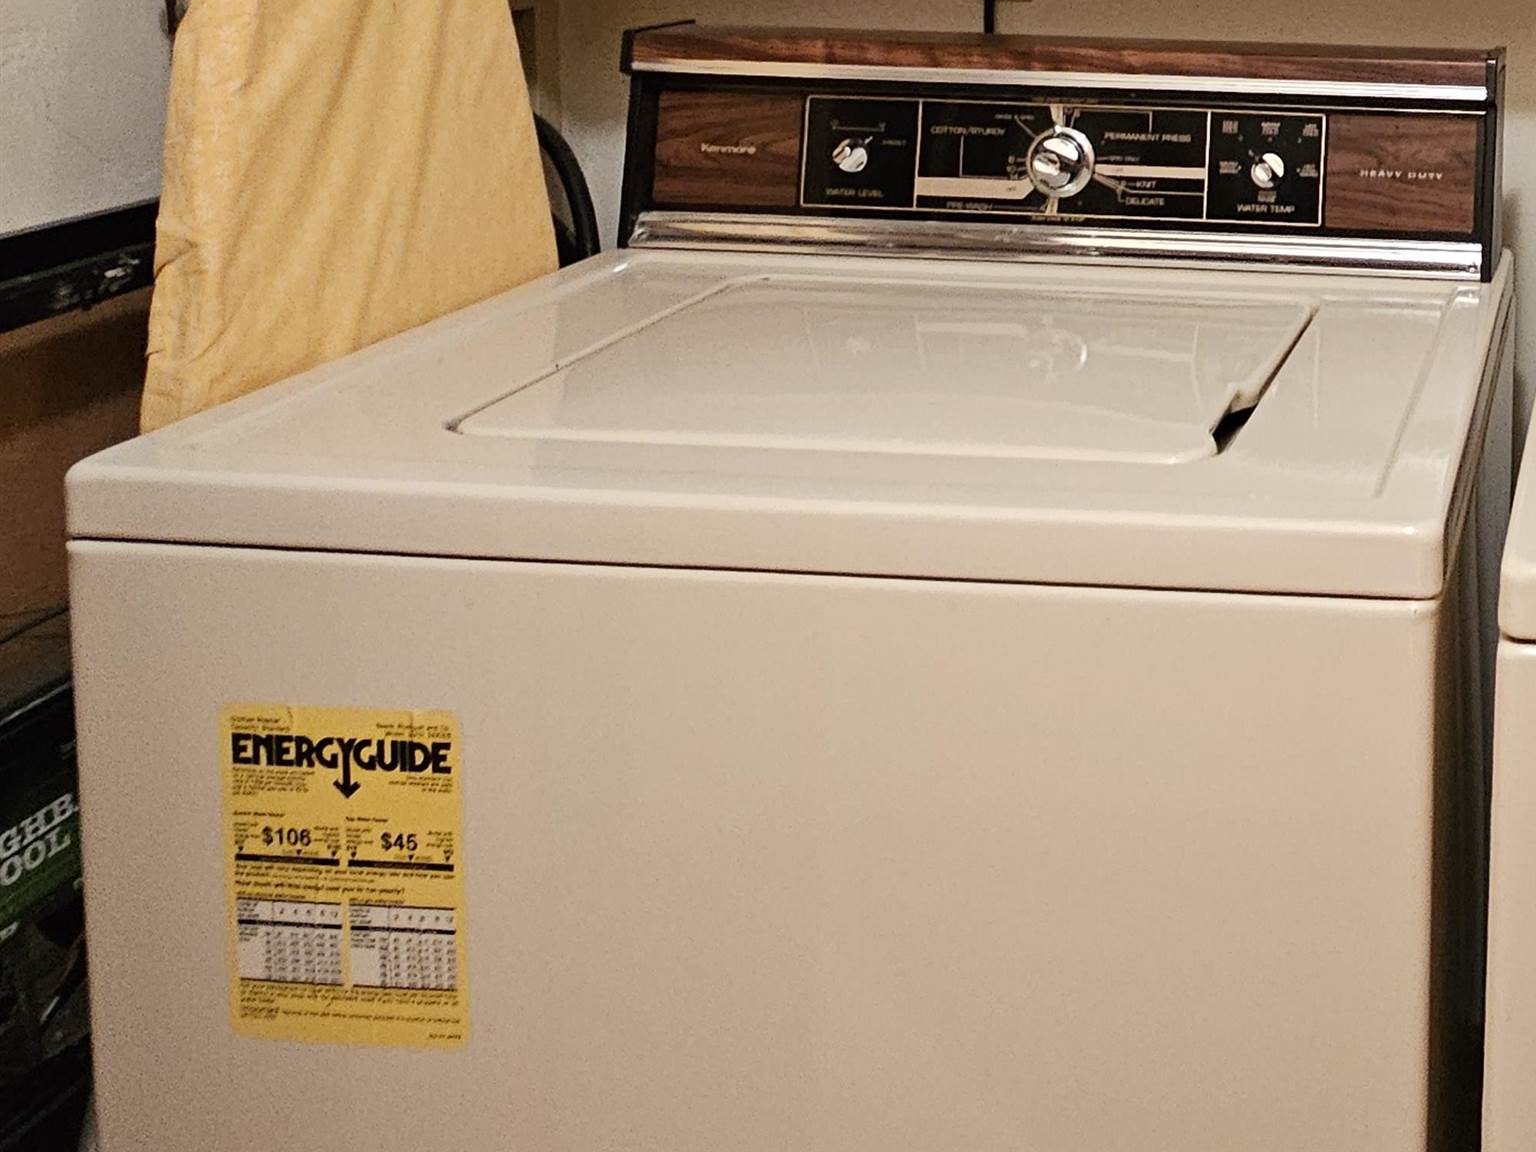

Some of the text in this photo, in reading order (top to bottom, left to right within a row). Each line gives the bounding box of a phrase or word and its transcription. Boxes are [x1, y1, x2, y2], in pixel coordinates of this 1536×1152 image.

[930, 125, 1006, 136] COTTON/STURDY
[1104, 132, 1192, 143] PERMANENT PRESS
[701, 142, 757, 155] Kenmore
[1360, 169, 1443, 180] HEAVY DUTY
[857, 189, 885, 198] LEVEL
[1125, 198, 1165, 207] DELICATE
[1237, 204, 1296, 214] WATER TEMP
[232, 732, 452, 778] ENERGYGUIDE
[262, 826, 418, 852] $106 $45
